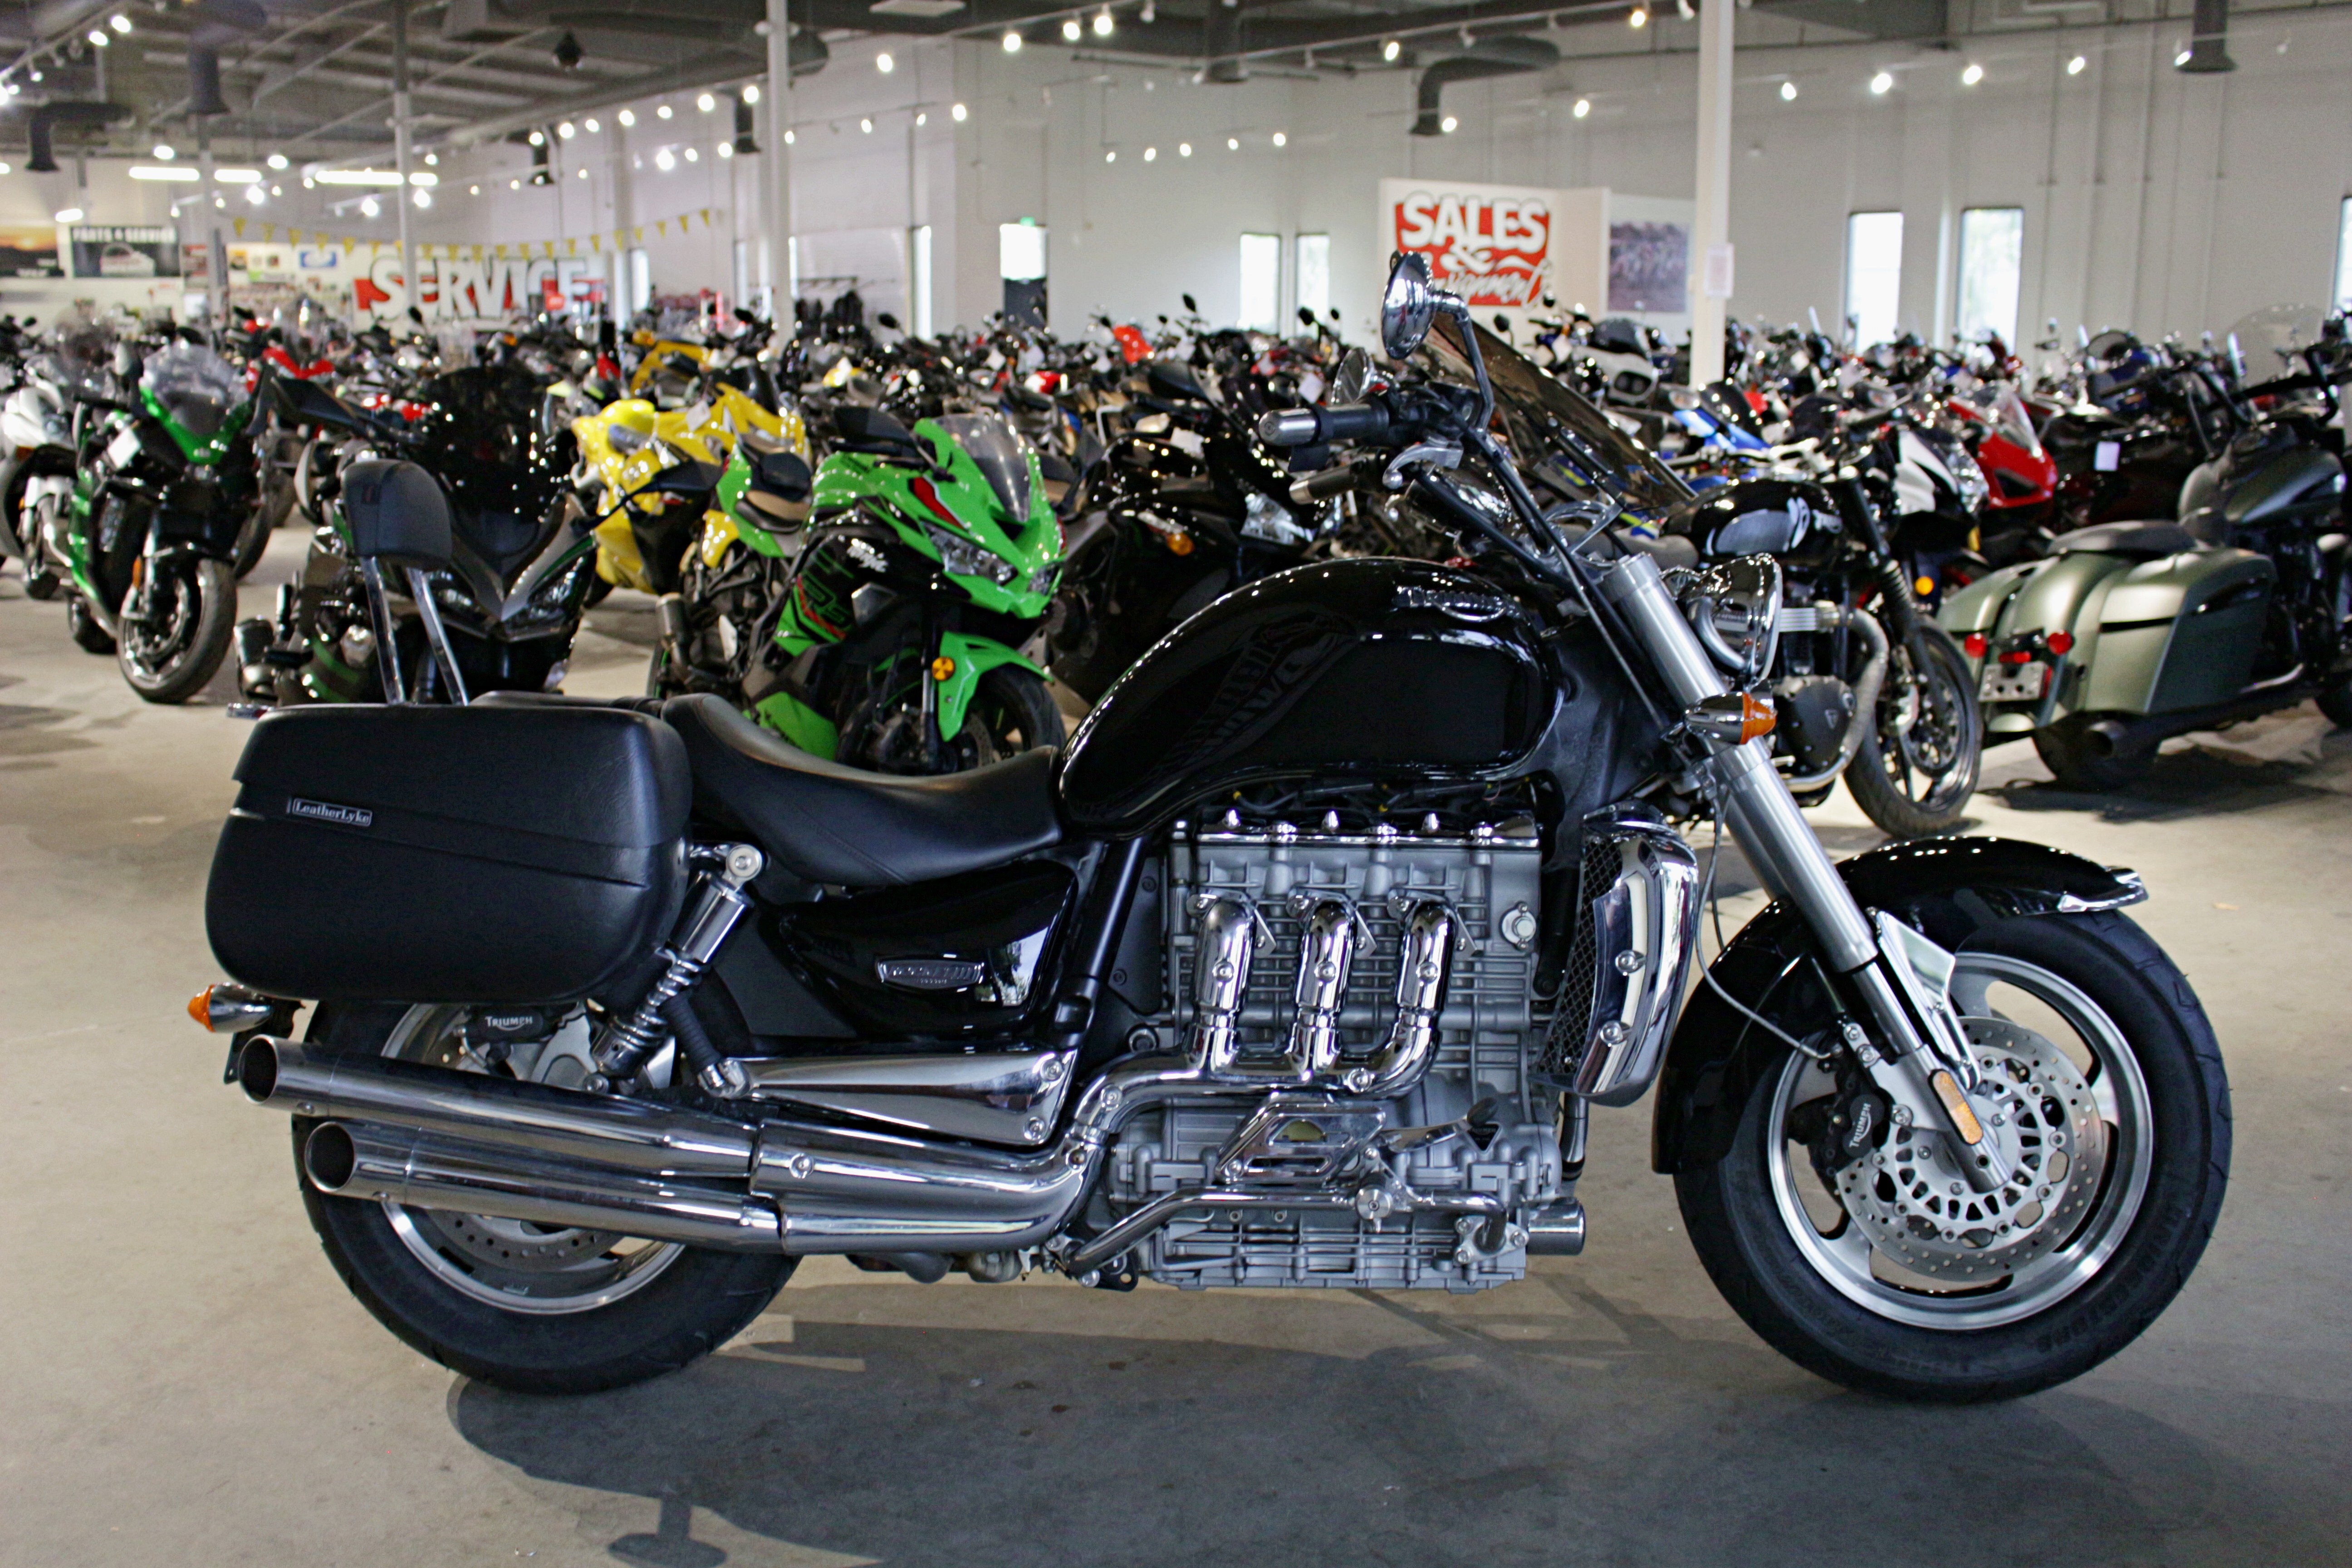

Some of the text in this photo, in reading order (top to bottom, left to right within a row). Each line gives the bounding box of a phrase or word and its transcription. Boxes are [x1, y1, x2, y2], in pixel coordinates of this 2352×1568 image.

[1400, 190, 1548, 254] SALES
[369, 255, 587, 320] SERVICE
[295, 801, 370, 823] LeatherLyke
[485, 1016, 533, 1028] TRIUMPH
[1849, 1102, 1872, 1147] TRIUMPH
